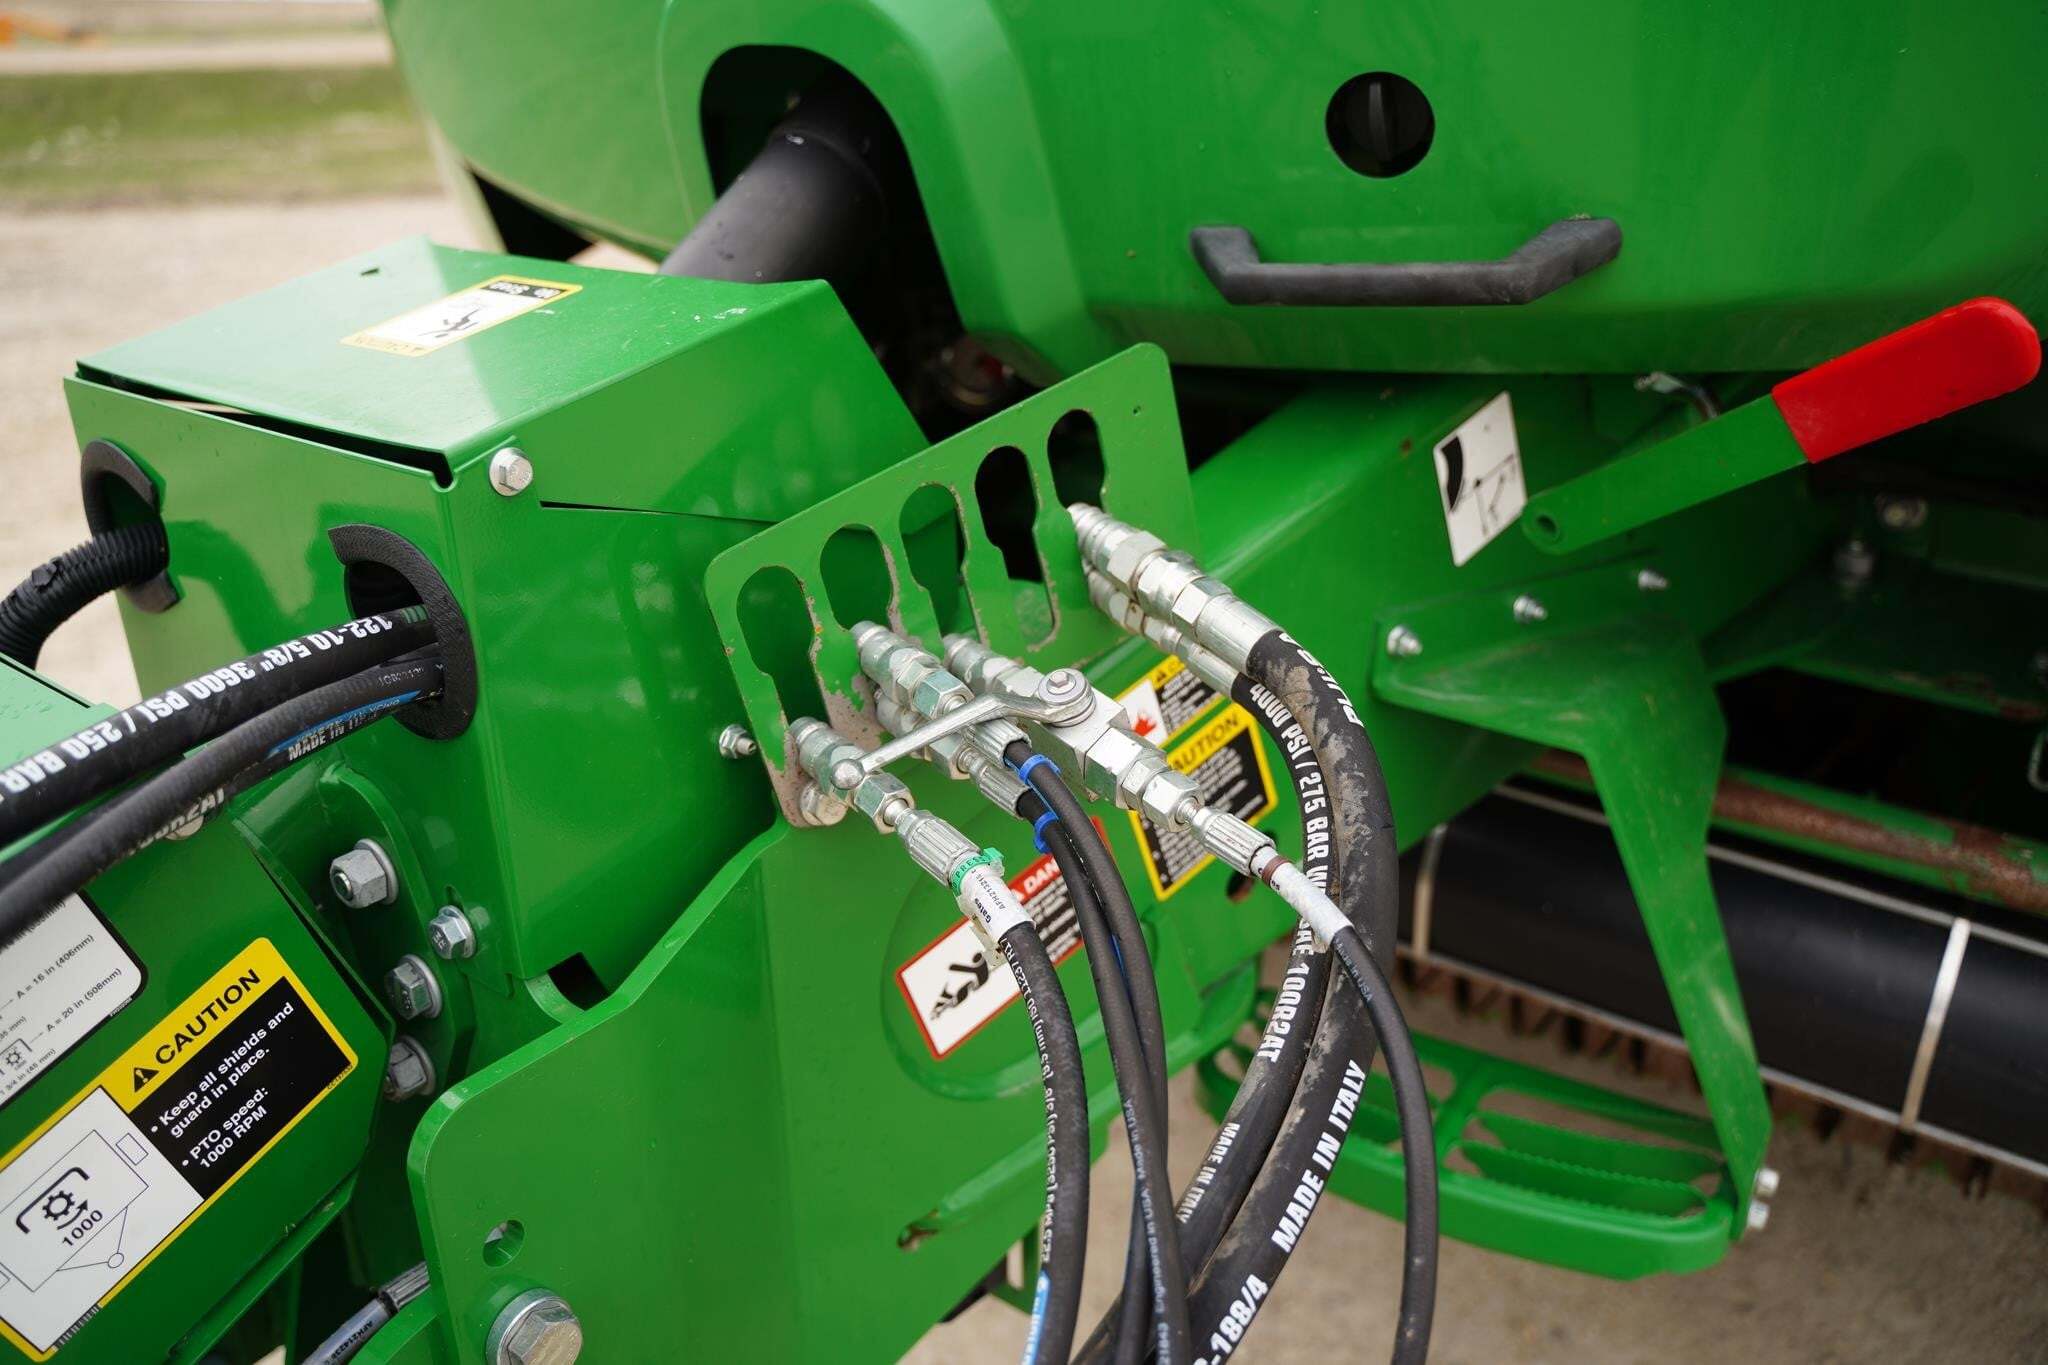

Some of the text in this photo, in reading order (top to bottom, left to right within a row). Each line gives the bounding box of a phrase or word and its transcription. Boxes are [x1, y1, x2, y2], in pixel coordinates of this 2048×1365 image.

[313, 616, 392, 650] 122-10
[261, 640, 311, 671] 5/8"
[186, 662, 255, 699] 3600
[137, 692, 189, 722] PSI
[62, 723, 122, 758] 250
[1281, 724, 1311, 760] PSI
[0, 754, 66, 792] BAR
[1300, 772, 1325, 813] 275
[1307, 817, 1328, 861] BAR
[975, 898, 991, 924] Gates
[17, 991, 24, 999] A
[33, 974, 44, 984] 16
[45, 967, 55, 975] in
[56, 935, 94, 967] (406mm)
[1357, 975, 1377, 1001] USA
[62, 1007, 73, 1018] 20
[74, 1000, 83, 1008] in
[84, 968, 121, 1000] (508mm)
[1257, 963, 1309, 1062] 100R2AT
[156, 969, 260, 1064] CAUTION
[160, 1003, 293, 1125] Keep all shields and
[171, 1049, 269, 1138] guard in place.
[190, 1088, 268, 1159] PTO speed:
[201, 1106, 266, 1167] 1000 RPM
[1134, 1144, 1146, 1179] Made
[1179, 1123, 1240, 1223] MADE IN ITALY
[1273, 1060, 1365, 1251] MADE IN ITALY
[63, 1210, 102, 1246] 1000
[1192, 1275, 1268, 1365] -188/4
